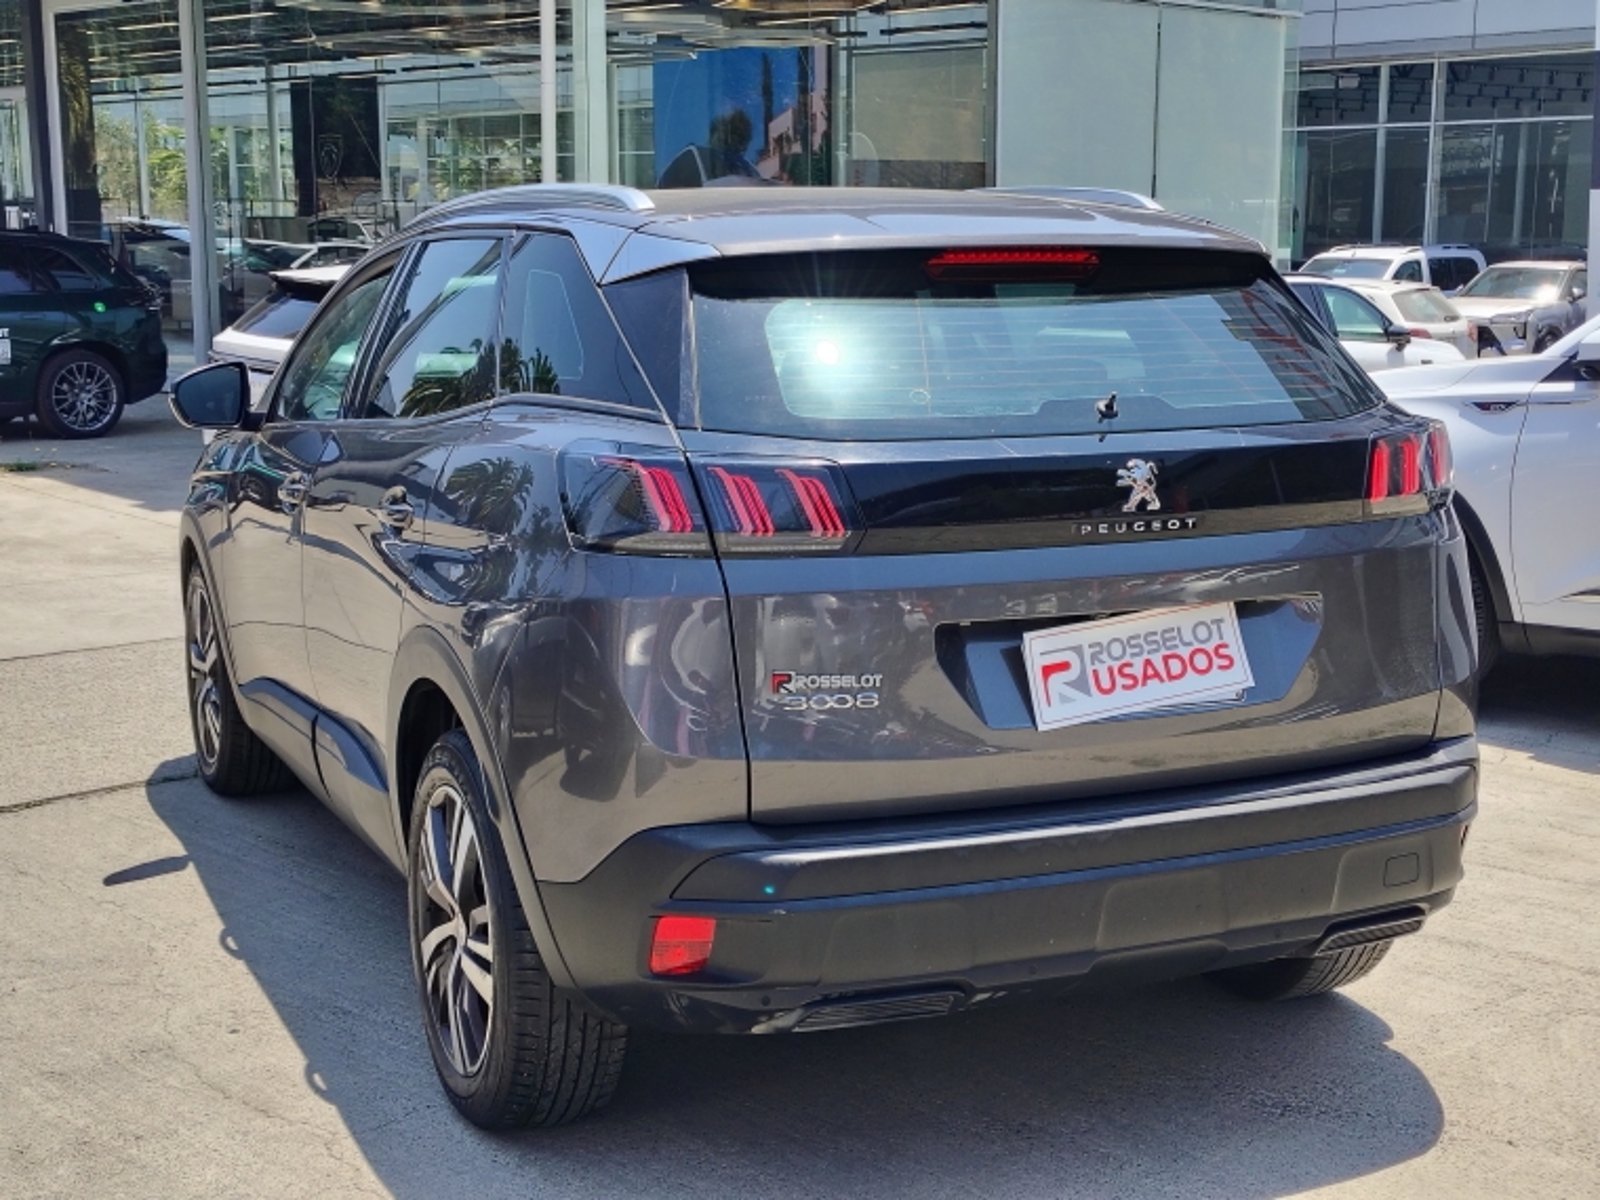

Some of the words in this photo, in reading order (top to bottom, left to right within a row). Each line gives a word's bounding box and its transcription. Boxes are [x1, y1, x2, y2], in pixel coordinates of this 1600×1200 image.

[1081, 518, 1197, 535] PEUGEOT
[1088, 618, 1226, 666] ROSSELOT
[1092, 642, 1235, 696] USADOS
[796, 674, 883, 689] ROSSELOT
[783, 692, 879, 710] 3008
